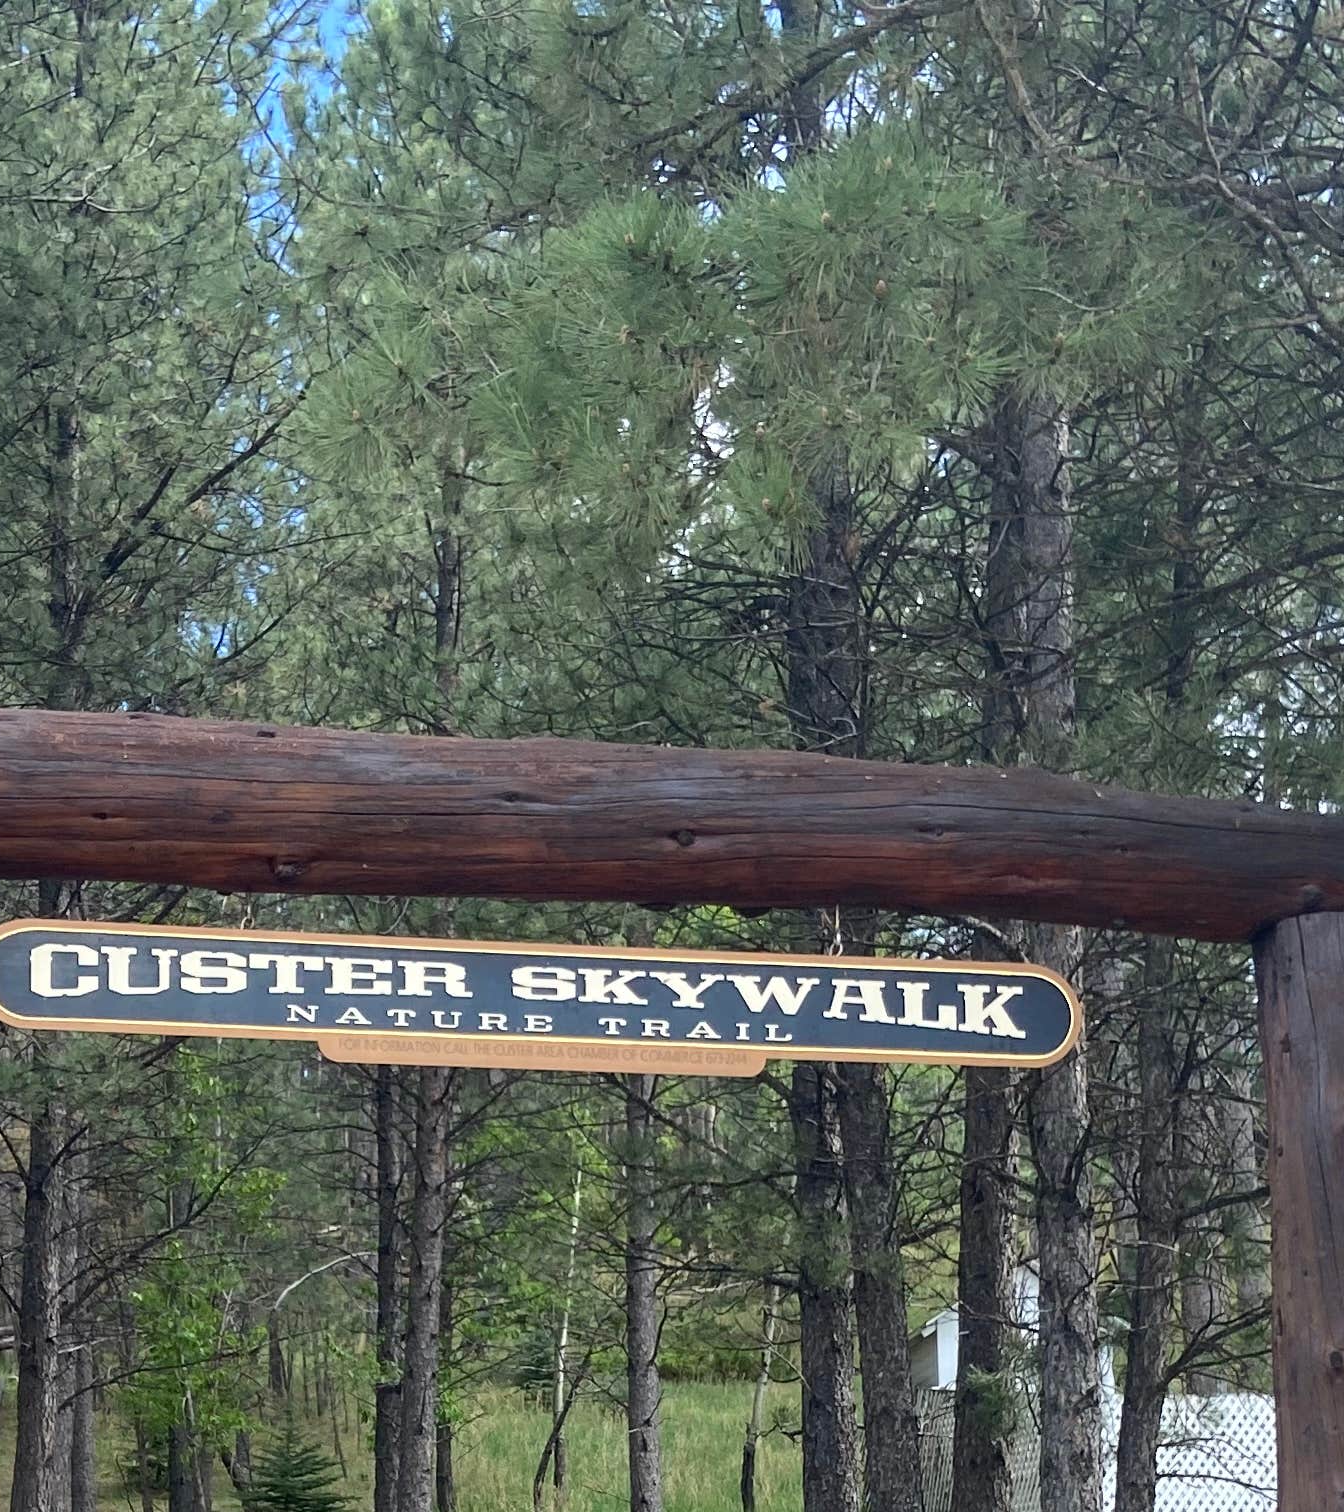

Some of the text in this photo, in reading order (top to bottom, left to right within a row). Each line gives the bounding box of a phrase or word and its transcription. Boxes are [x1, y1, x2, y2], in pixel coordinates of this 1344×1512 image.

[30, 943, 1026, 1040] CUSTER SKYWALK
[286, 1004, 793, 1043] NATURE TRAIL
